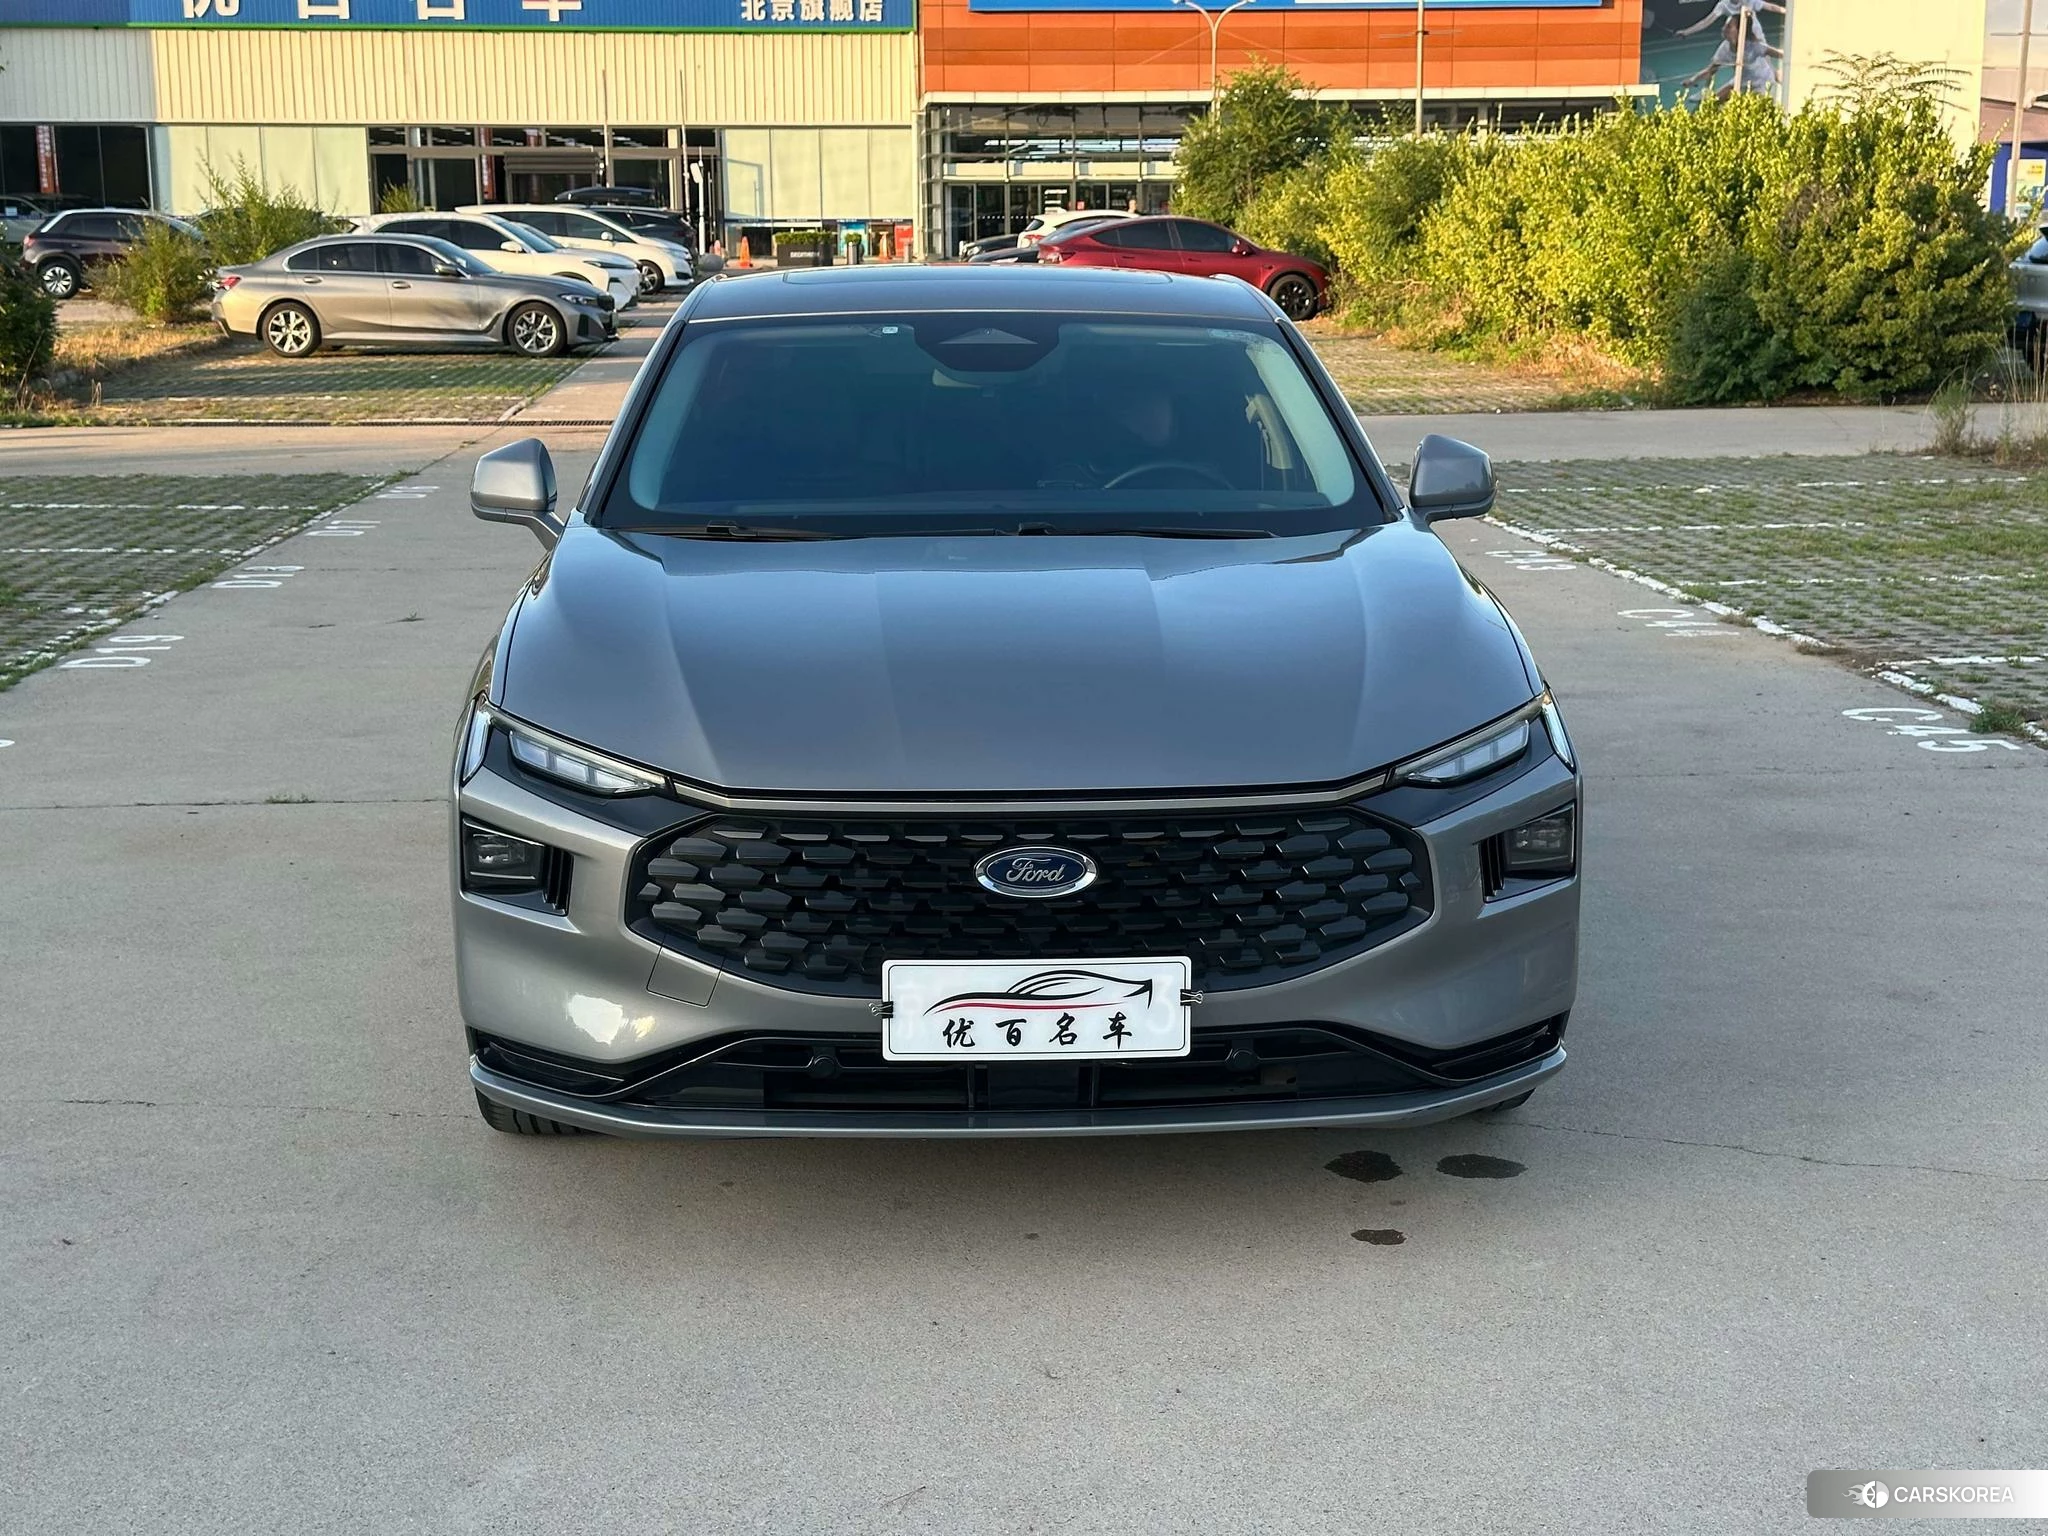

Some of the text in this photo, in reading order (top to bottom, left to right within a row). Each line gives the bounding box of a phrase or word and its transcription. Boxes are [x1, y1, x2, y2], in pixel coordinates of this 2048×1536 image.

[741, 0, 883, 22] 北京旗舰店
[59, 634, 185, 668] D19
[1841, 707, 2023, 753] C45
[1006, 857, 1066, 882] Ford
[942, 1011, 1132, 1050] 优百名车
